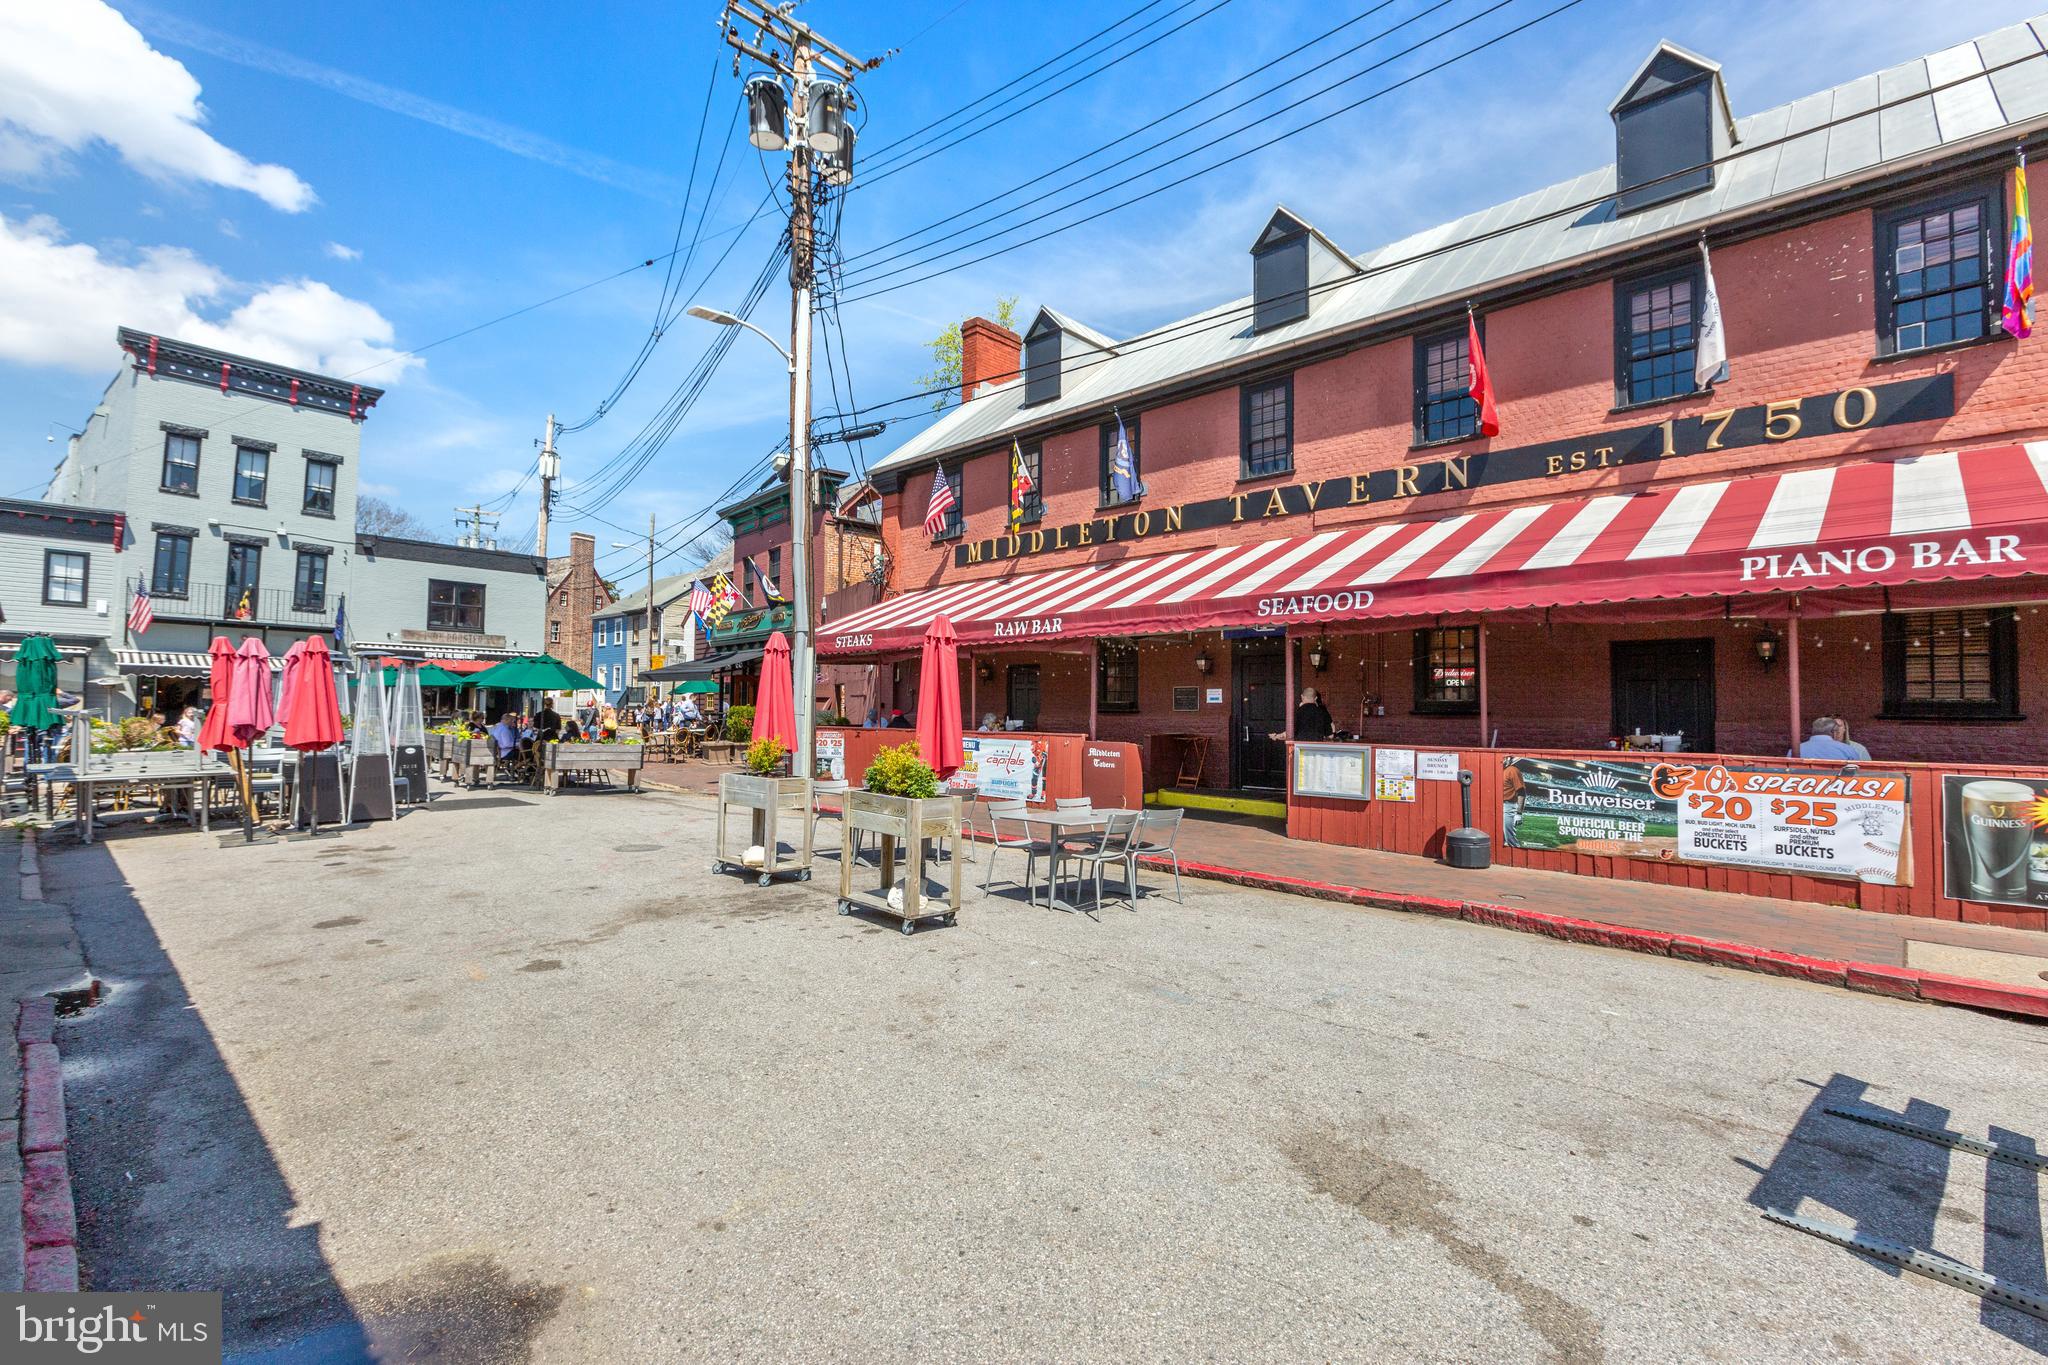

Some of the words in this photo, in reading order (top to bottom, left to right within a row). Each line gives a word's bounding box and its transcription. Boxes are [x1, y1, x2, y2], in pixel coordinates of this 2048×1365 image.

[966, 504, 1184, 563] MIDDLETON
[1229, 456, 1472, 522] TAVERN
[1546, 446, 1624, 476] EST.
[1659, 387, 1878, 458] 1750
[1740, 546, 1896, 581] PIANO
[1909, 534, 2027, 569] BAR
[1257, 590, 1375, 617] SEAFOOD
[994, 620, 1030, 637] RAW
[1031, 618, 1063, 634] BAR
[835, 634, 873, 648] STEAKS
[963, 741, 976, 749] ENU
[1744, 775, 1896, 798] SPECIALS!
[1548, 788, 1655, 811] Budweiser
[1688, 793, 1753, 821] $20
[1770, 798, 1838, 828] $25
[1844, 802, 1902, 815] MIDDLETON
[1557, 816, 1571, 826] AN
[1572, 818, 1616, 830] OFFICIAL
[1618, 821, 1646, 833] BEER
[1971, 814, 2027, 829] GUINNESS
[1559, 826, 1606, 839] SPONSOR
[1607, 830, 1622, 840] OF
[1623, 831, 1644, 843] THE
[1694, 831, 1723, 839] DOMESTIC
[1724, 833, 1747, 841] BOTTLE
[1789, 838, 1820, 846] PREMIUM
[1577, 840, 1619, 852] ORIOLES
[1694, 837, 1748, 852] BUCKETS
[1775, 843, 1835, 859] BUCKETS
